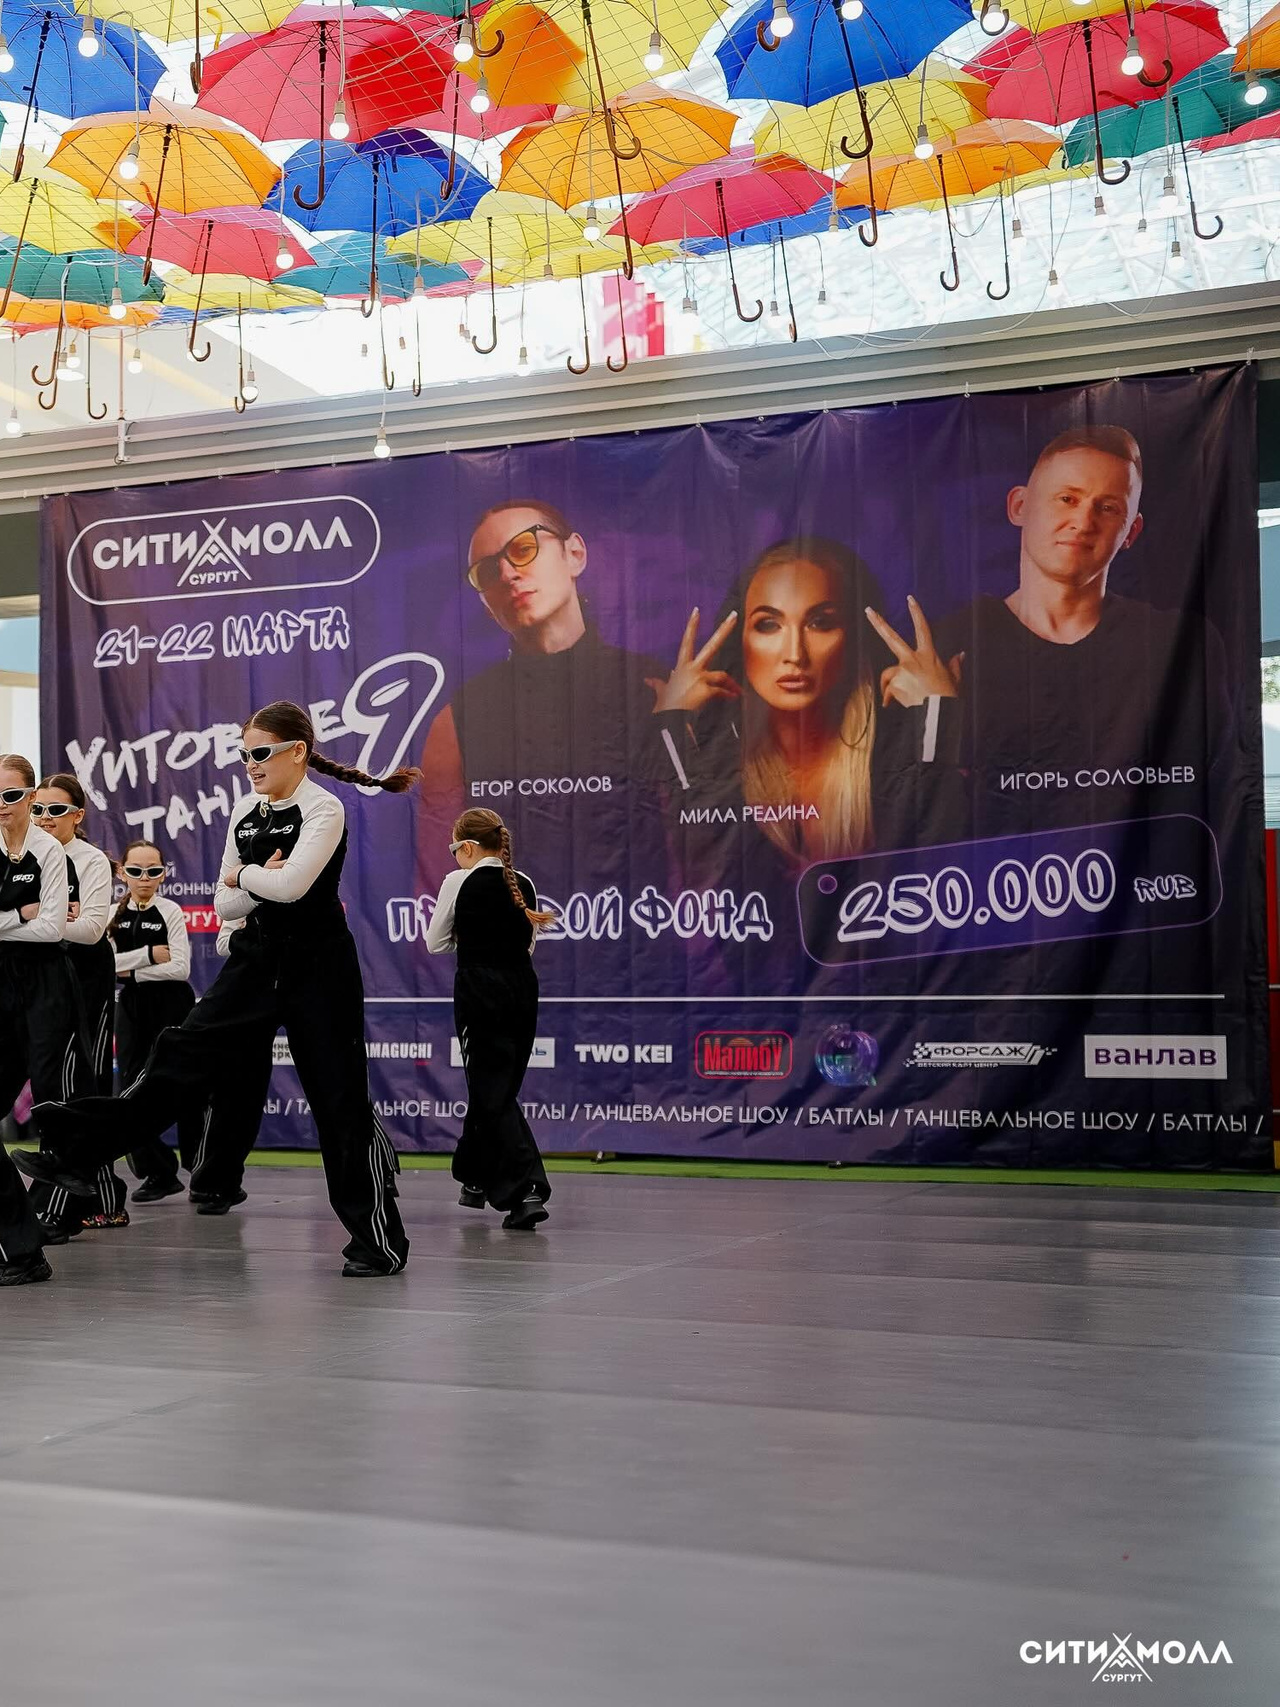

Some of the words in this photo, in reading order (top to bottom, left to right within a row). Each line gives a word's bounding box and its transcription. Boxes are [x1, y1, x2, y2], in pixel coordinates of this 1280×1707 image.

[189, 570, 239, 586] СУРГУТ
[93, 621, 214, 668] 21-22
[223, 606, 351, 658] МАРТА
[65, 699, 347, 812] ХИТОВЕ
[471, 780, 514, 797] ЕГОР
[519, 776, 612, 796] СОКОЛОВ
[1000, 770, 1069, 790] ИГОРЬ
[1075, 766, 1196, 788] СОЛОВЬЕВ
[679, 807, 737, 825] МИЛА
[742, 804, 820, 824] РЕДИНА
[837, 848, 1117, 943] 250.000
[1133, 874, 1198, 902] RUB
[386, 885, 622, 943] ПРВОЙ
[629, 884, 774, 942] ФОНД
[574, 1044, 627, 1063] TWO
[634, 1045, 673, 1063] KEI
[933, 1046, 1026, 1057] ФОРСАЖ
[1094, 1047, 1218, 1067] ванлав
[435, 1101, 468, 1119] ШО
[584, 1103, 733, 1124] ТАНЦЕВАЛЬНОЕ
[739, 1105, 789, 1125] ШОУ
[809, 1107, 883, 1127] БАТТЛЫ
[904, 1108, 1075, 1130] ТАНЦЕВАЛЬНОЕ
[1082, 1111, 1139, 1132] ШОУ
[1163, 1113, 1247, 1133] БАТТЛЫ
